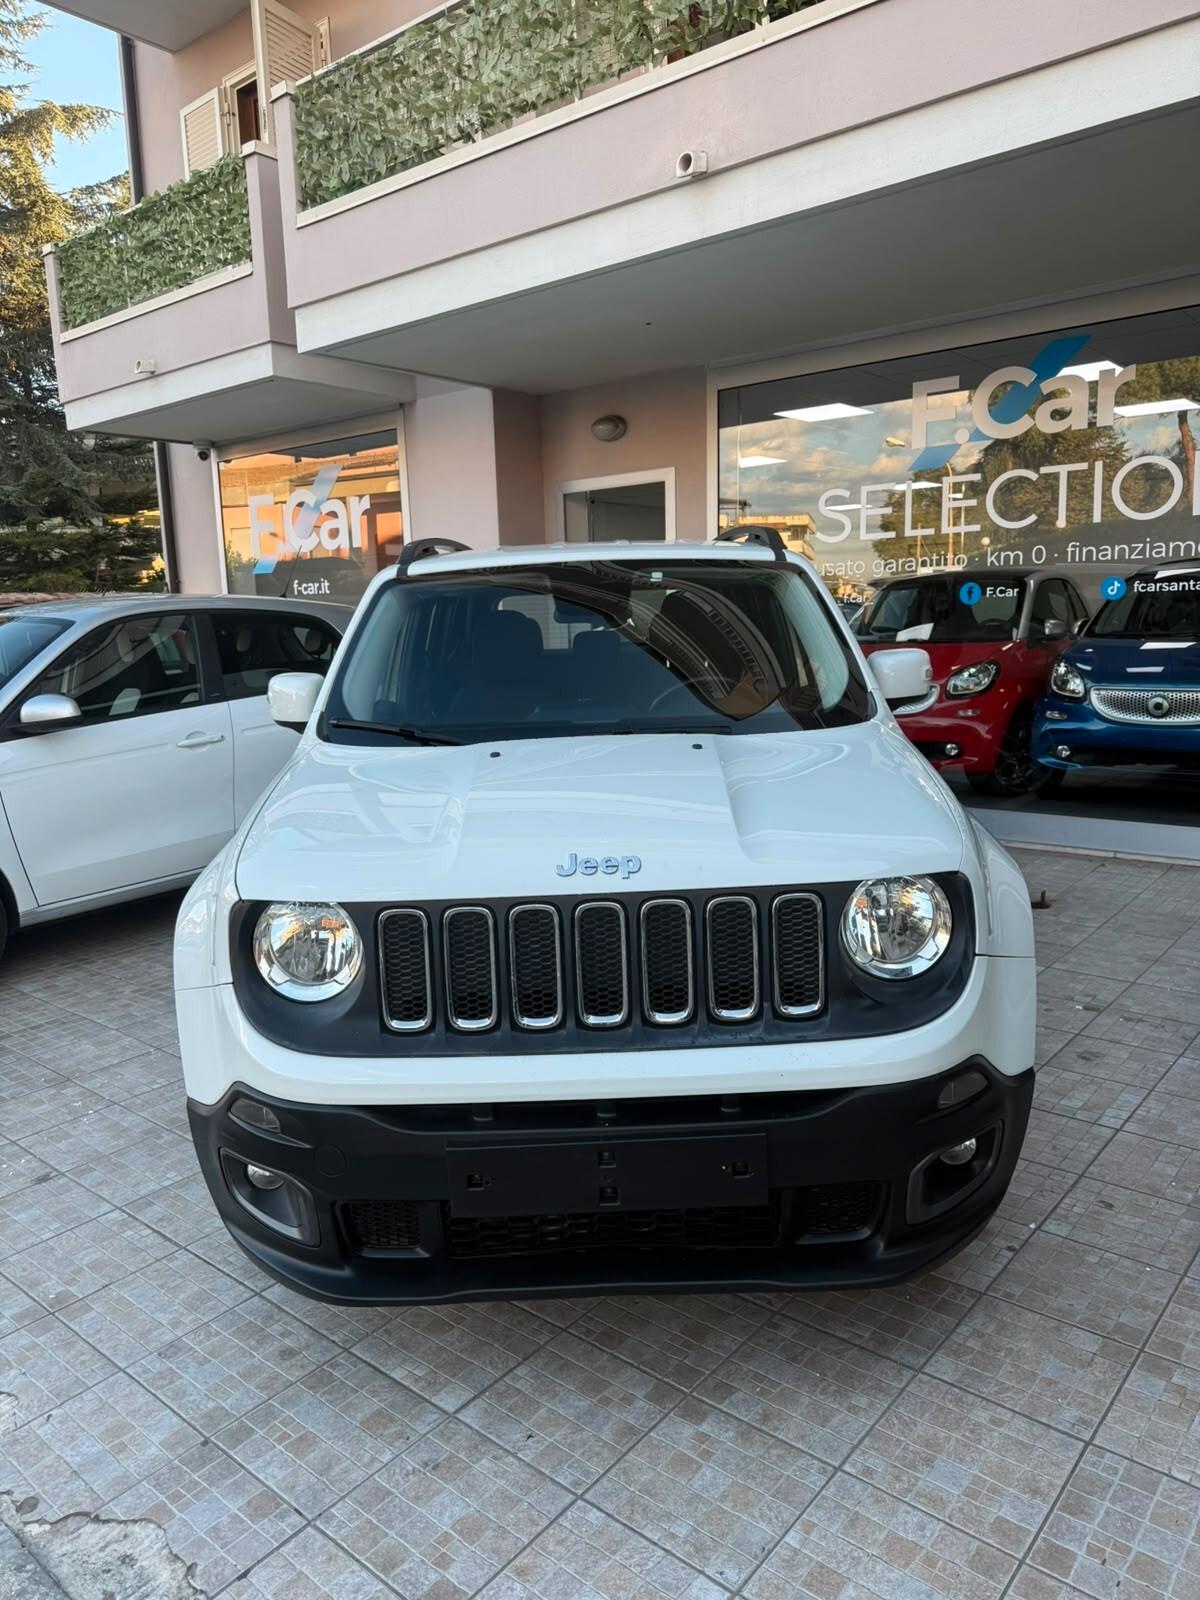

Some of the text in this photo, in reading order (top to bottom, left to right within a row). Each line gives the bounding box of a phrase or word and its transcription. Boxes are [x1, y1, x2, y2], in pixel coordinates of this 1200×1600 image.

[911, 363, 1137, 450] F.Car
[815, 451, 1200, 543] SELECTIO
[248, 488, 371, 560] F.Car
[872, 551, 968, 578] garantito
[986, 547, 1024, 567] km
[1032, 545, 1047, 565] 0
[293, 578, 331, 595] f-car.it
[985, 585, 1020, 598] F.Car
[555, 852, 642, 880] Jeep
